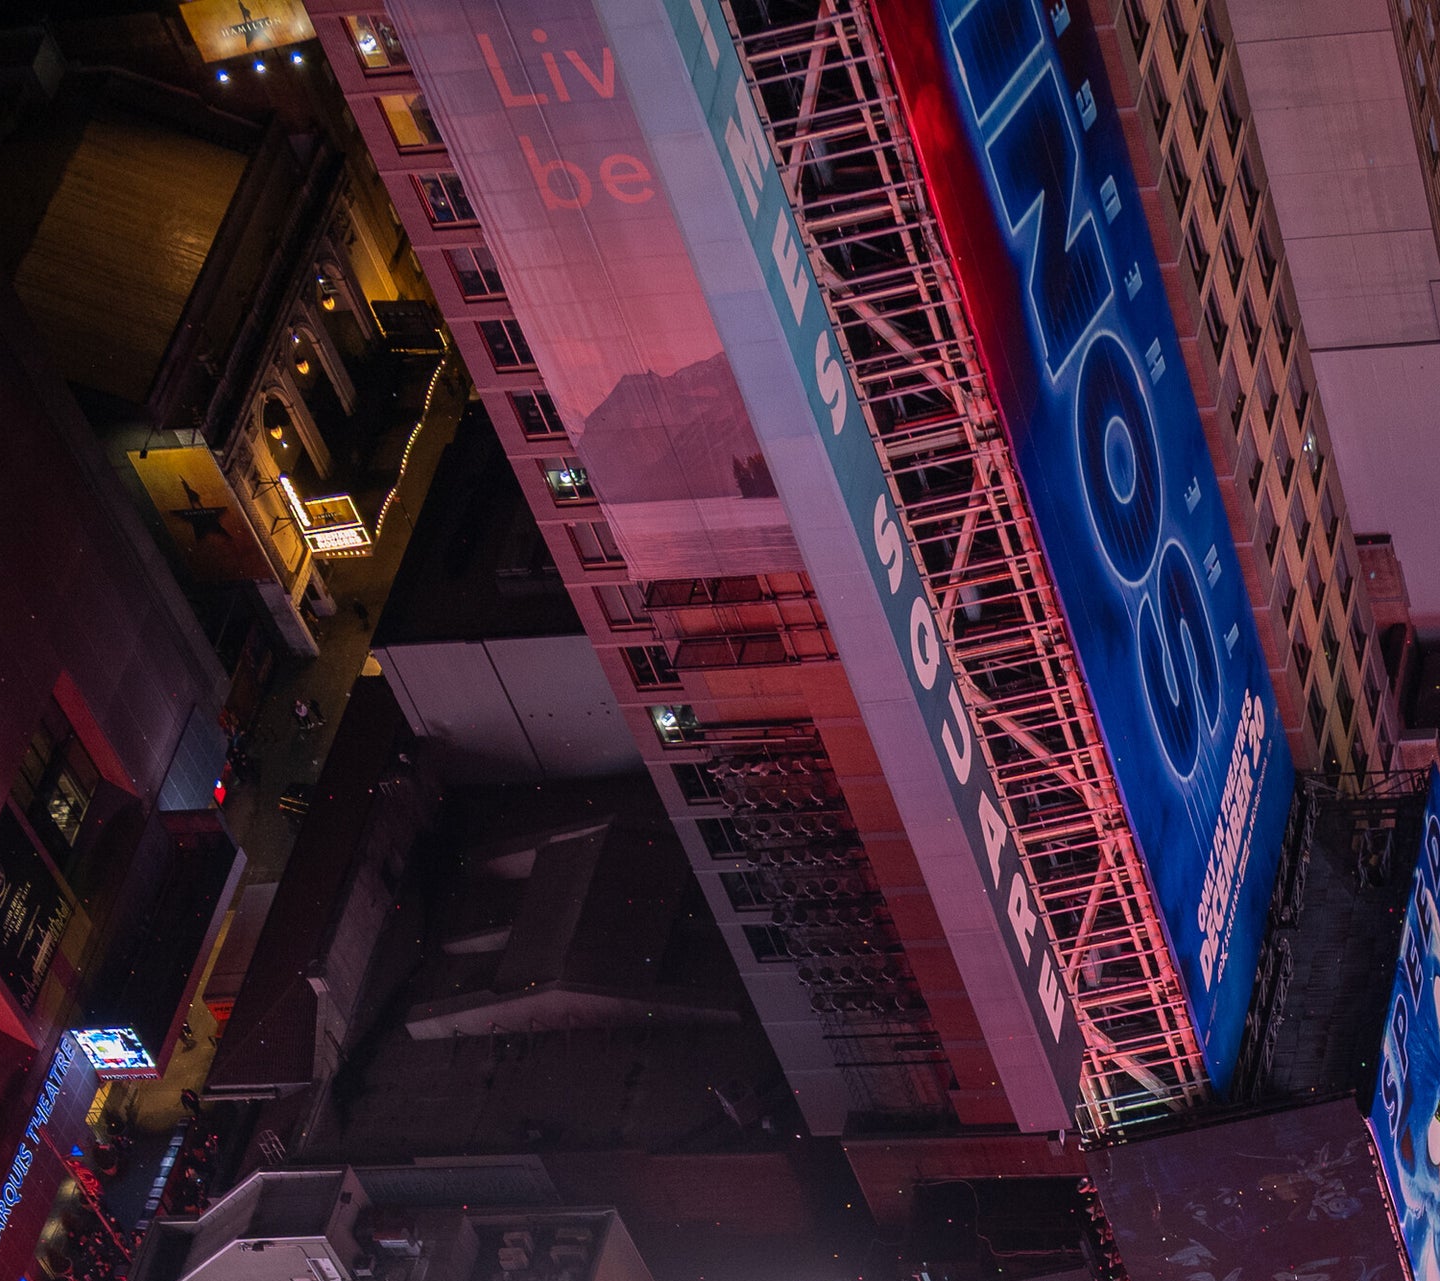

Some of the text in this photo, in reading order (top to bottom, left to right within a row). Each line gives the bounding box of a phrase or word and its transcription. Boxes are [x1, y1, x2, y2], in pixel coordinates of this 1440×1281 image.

[221, 17, 282, 38] HAMILTON
[519, 135, 655, 211] be
[872, 492, 1065, 1045] SQUARE
[1197, 687, 1252, 932] ONLY IN THEATRES
[1199, 754, 1254, 992] DECEMBER
[1248, 694, 1266, 770] 20
[29, 1039, 78, 1146] THEATRE
